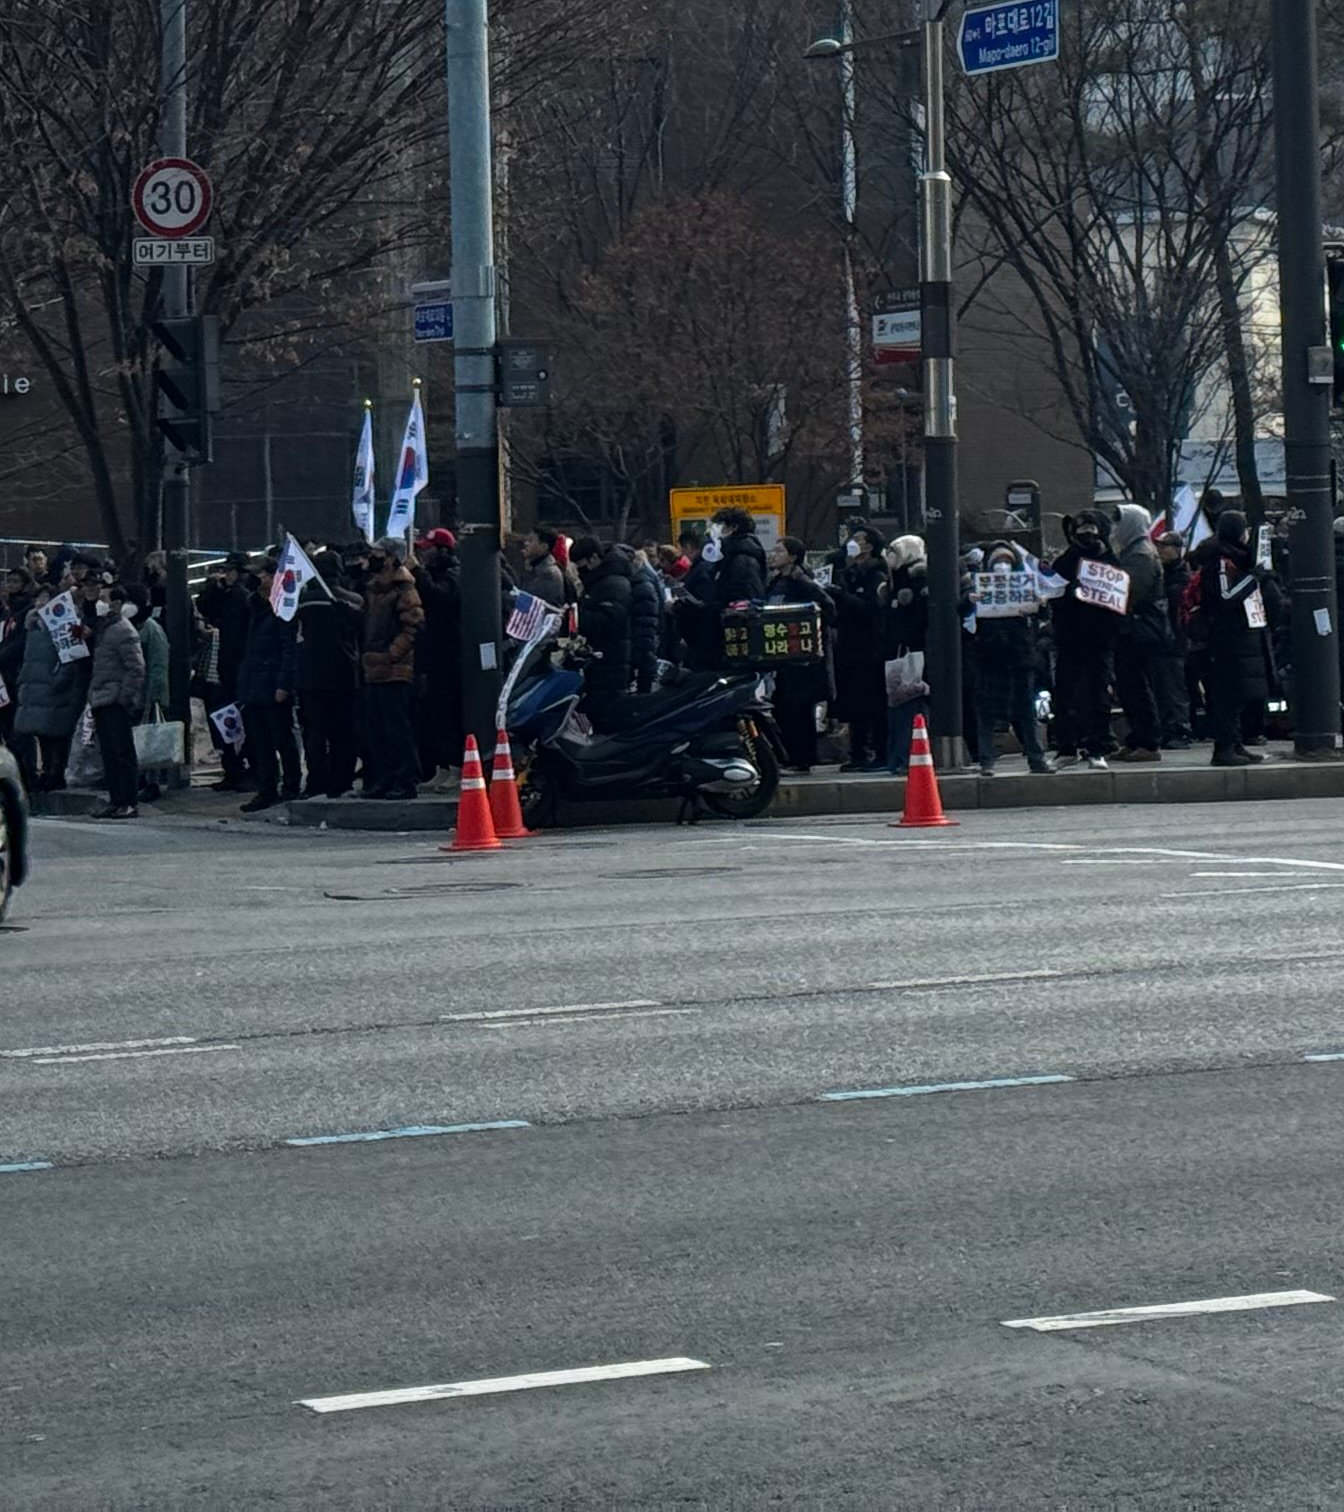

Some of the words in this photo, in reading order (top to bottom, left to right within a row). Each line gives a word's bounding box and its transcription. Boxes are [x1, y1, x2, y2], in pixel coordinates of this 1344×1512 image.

[984, 0, 1054, 40] 마포대로12길
[978, 41, 1029, 65] Mapo-daero
[150, 180, 196, 215] 30
[137, 240, 210, 261] 여기부터
[1088, 563, 1124, 584] STOP
[1080, 585, 1122, 609] STEAL
